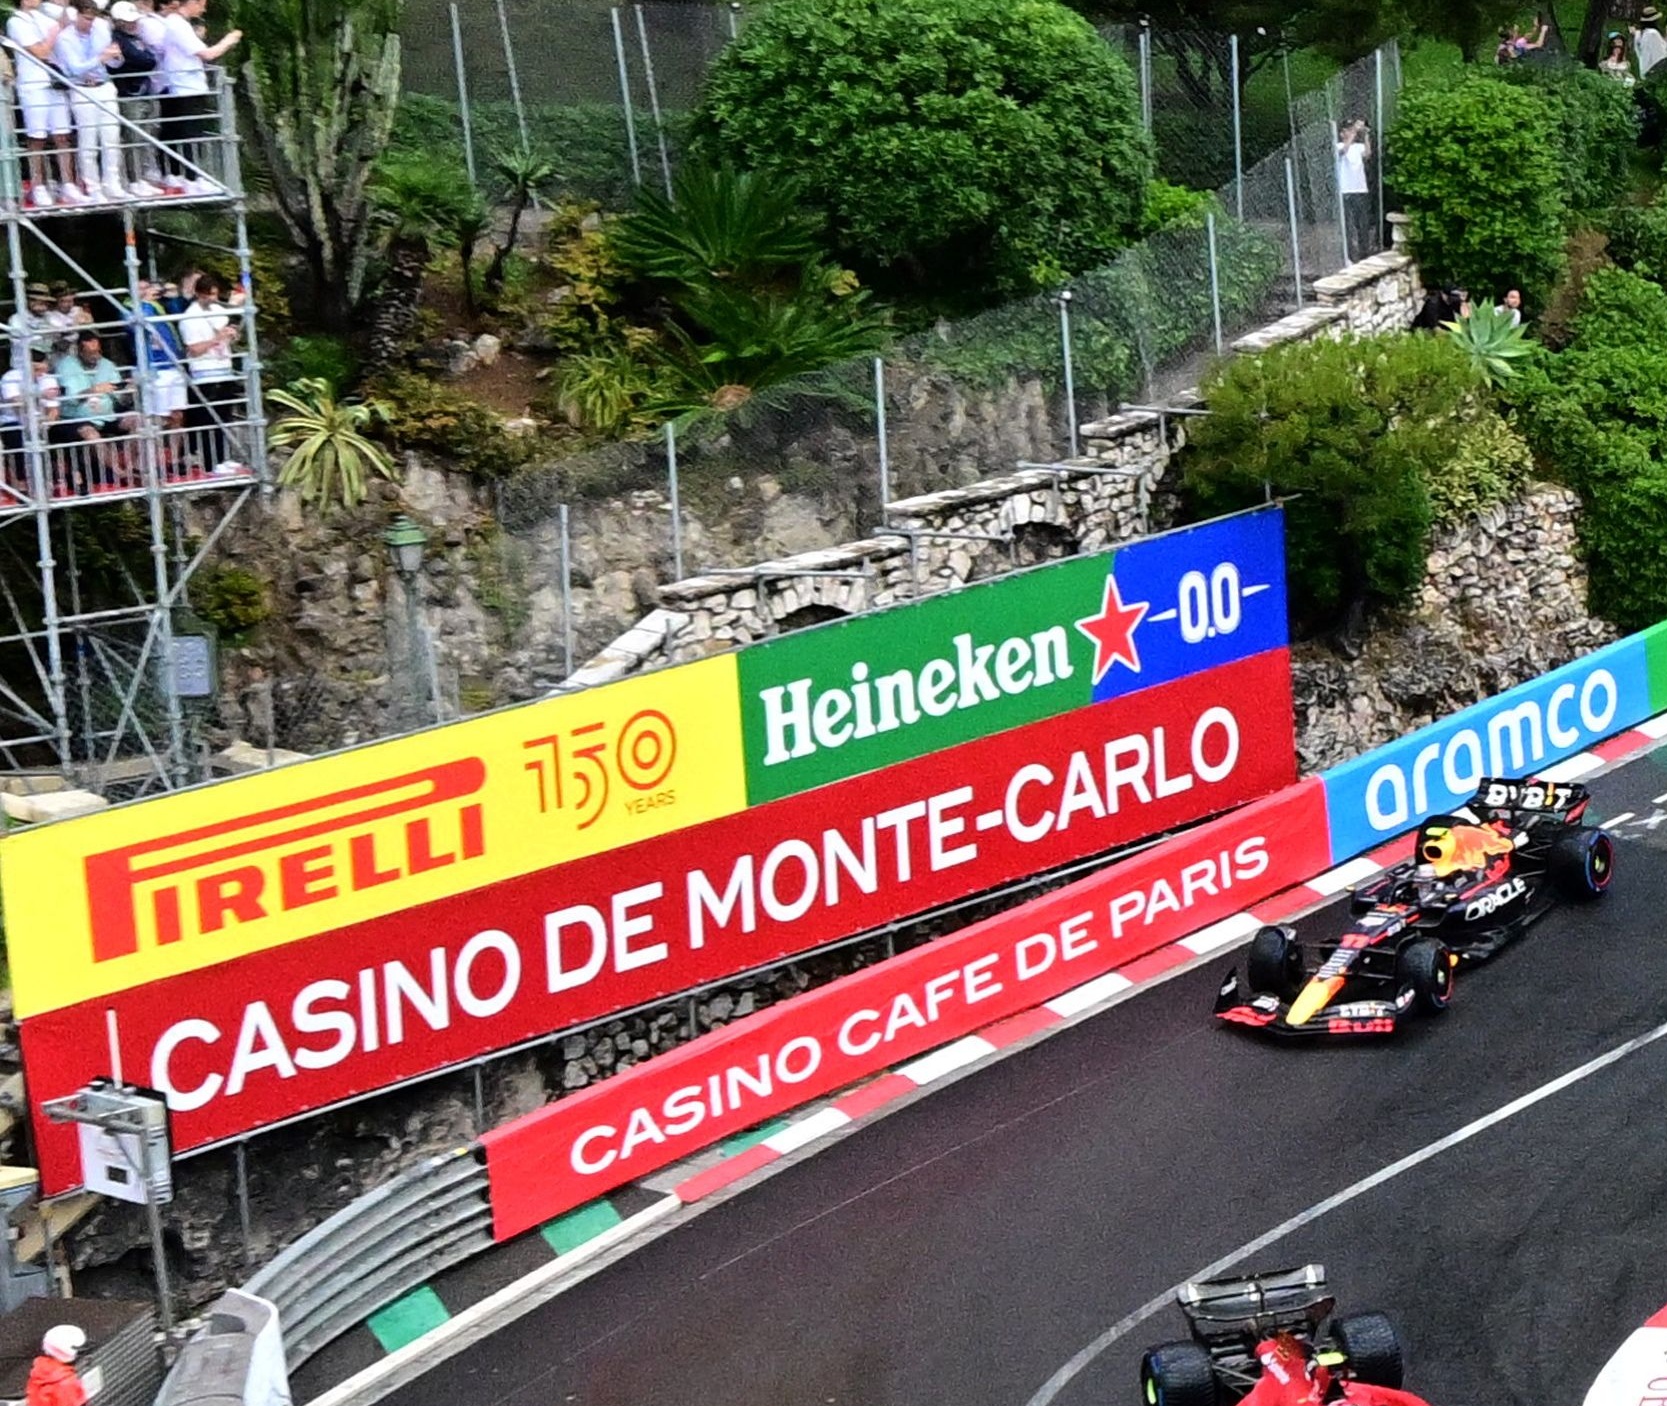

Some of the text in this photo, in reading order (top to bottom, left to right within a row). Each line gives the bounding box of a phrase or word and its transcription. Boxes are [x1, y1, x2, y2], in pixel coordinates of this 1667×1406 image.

[523, 709, 677, 831] 150
[760, 624, 1073, 767] Heineken
[1364, 668, 1618, 831] aramco
[84, 756, 486, 963] PIRELLI
[624, 789, 677, 816] YEARS
[152, 706, 1239, 1111] CASINO DE MONTE-CARLO
[1465, 877, 1526, 921] ORACLE
[570, 836, 1270, 1176] CASINO CAFE DE PARIS
